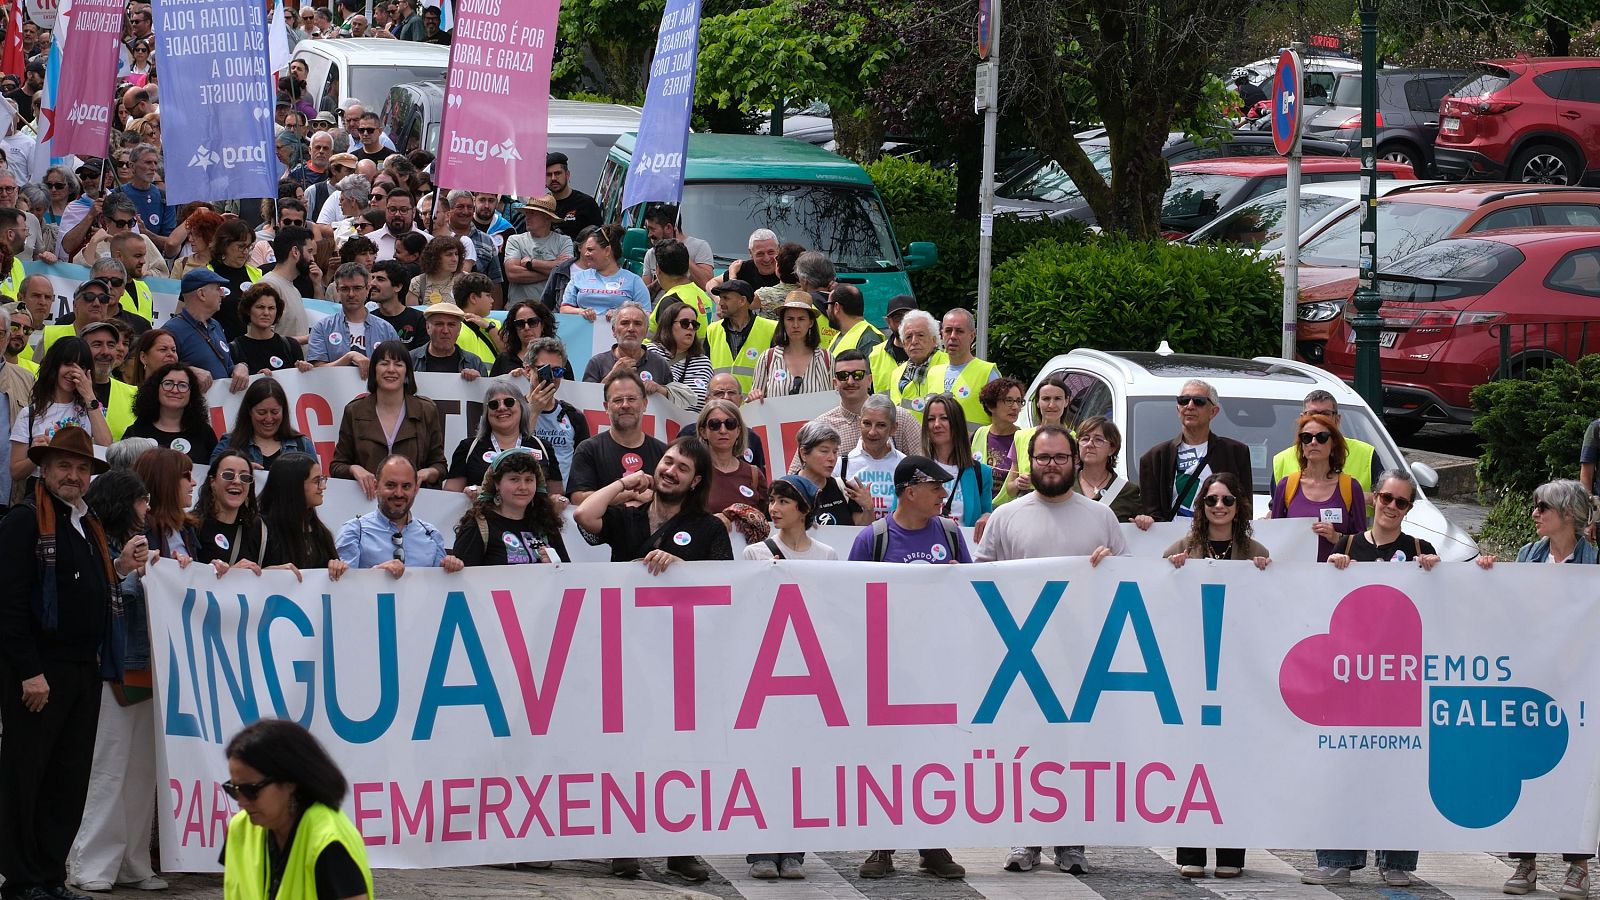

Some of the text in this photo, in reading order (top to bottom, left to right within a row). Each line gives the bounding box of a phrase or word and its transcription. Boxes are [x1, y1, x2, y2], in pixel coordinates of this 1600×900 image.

[460, 0, 502, 17] SOMOS
[456, 17, 545, 49] GALEGOS É POR
[453, 42, 534, 73] OBRA E GRAZA
[449, 67, 510, 96] DO IDIOMA
[450, 130, 489, 162] bng
[858, 470, 893, 483] UNHA
[1332, 654, 1513, 684] QUEREMOS
[1432, 699, 1562, 727] GALEGO
[1318, 735, 1423, 750] PLATAFORMA
[169, 745, 1223, 848] PAR EMERXENCIA LINGÜÍSTICA
